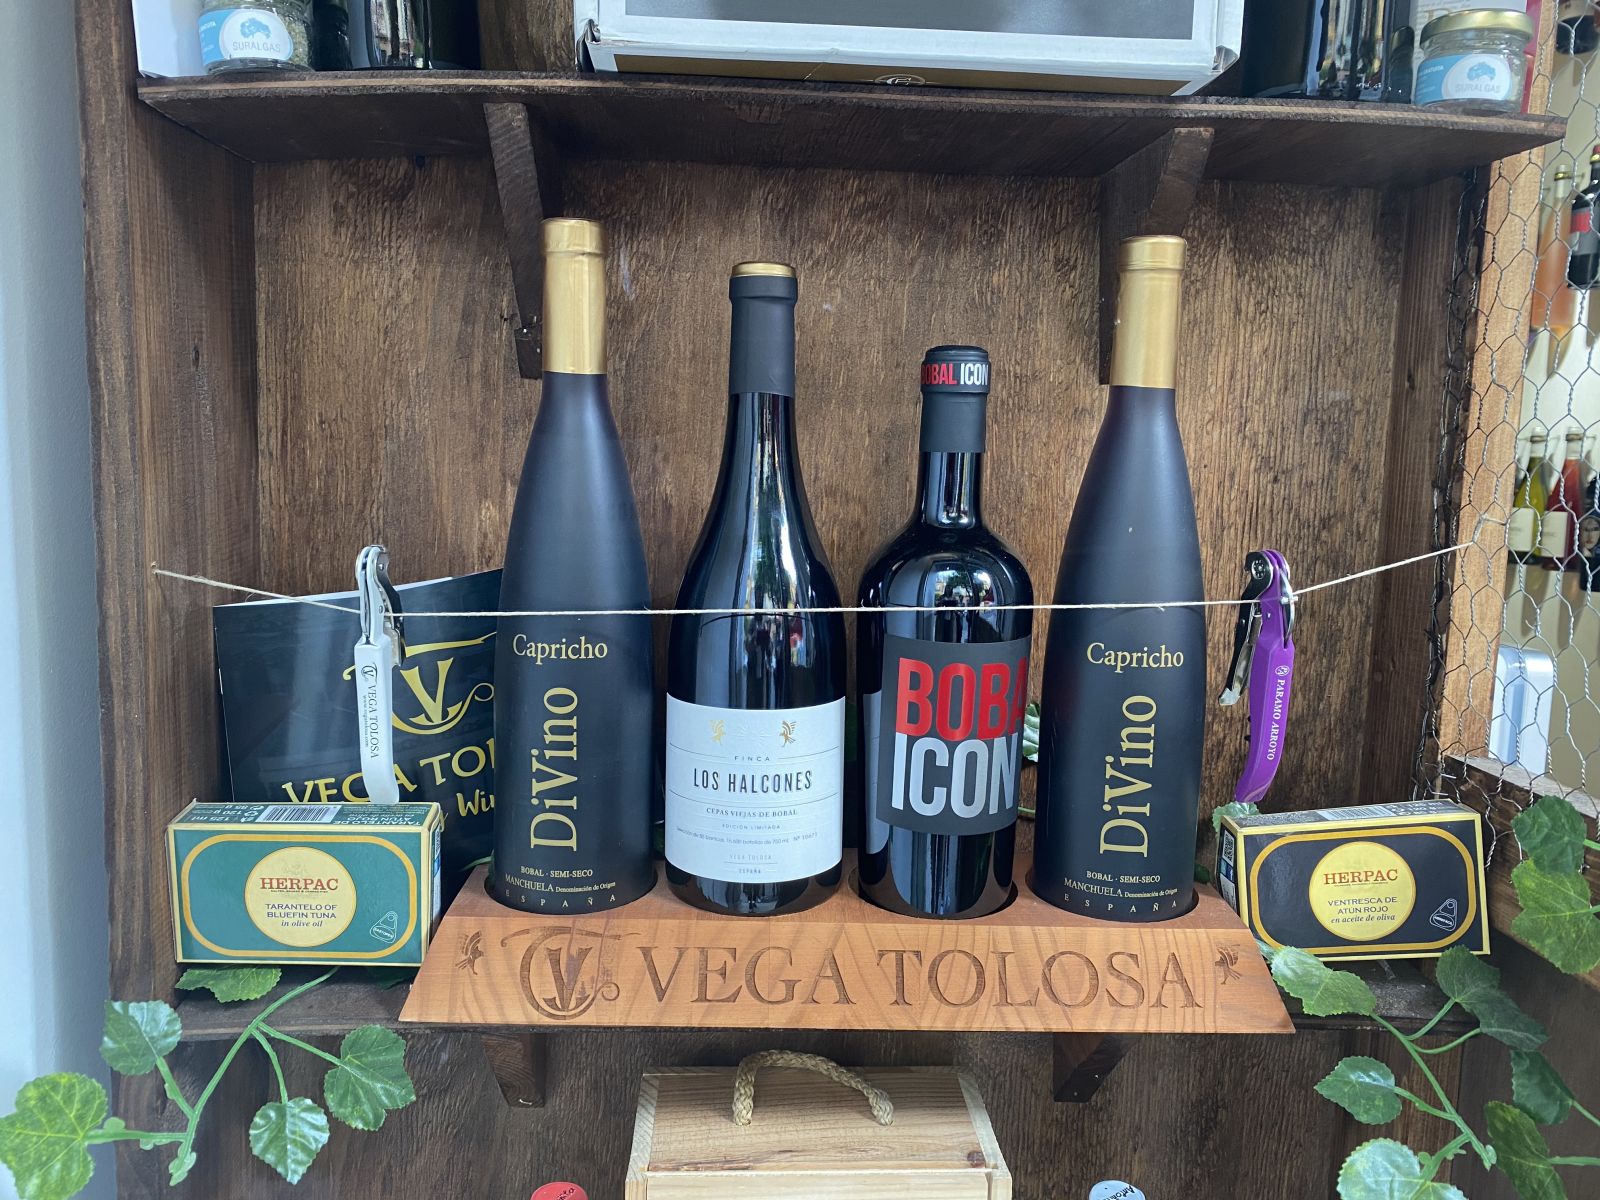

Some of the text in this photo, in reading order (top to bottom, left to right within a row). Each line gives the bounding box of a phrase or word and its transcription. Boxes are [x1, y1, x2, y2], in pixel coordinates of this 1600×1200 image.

[232, 41, 281, 52] SURALGAS
[1455, 83, 1501, 94] SURALGAS
[921, 362, 989, 385] OBAL ICON
[513, 634, 608, 665] Capricho
[1086, 642, 1184, 673] Capricho
[368, 684, 380, 759] VEGA TOLOSA
[1266, 679, 1286, 761] PARAMO ARROYO
[530, 687, 578, 851] DiVino
[891, 731, 1018, 818] ICON
[1100, 695, 1157, 858] DiVino
[693, 768, 812, 793] LOS HALCONES
[706, 807, 729, 817] CEPAS
[730, 810, 757, 819] VIEJAS
[772, 809, 798, 818] BOBAL
[520, 866, 593, 878] BOBAL SEMI-SECO
[1086, 870, 1160, 884] BOBAL SEMI-SECO
[1323, 869, 1398, 885] HERPAC
[259, 877, 339, 891] HERPAC
[505, 873, 554, 892] MANCHUELA
[1064, 877, 1123, 897] MANCHUELA
[266, 903, 322, 911] TARANTELO
[1328, 896, 1398, 907] VENTRESCA DE
[1364, 905, 1389, 913] ROJO
[267, 911, 308, 919] BLUEFIN
[1341, 915, 1362, 923] aceite
[1365, 914, 1375, 922] de
[1376, 913, 1396, 921] oliva
[636, 945, 1204, 1009] VEGA TOLOSA
